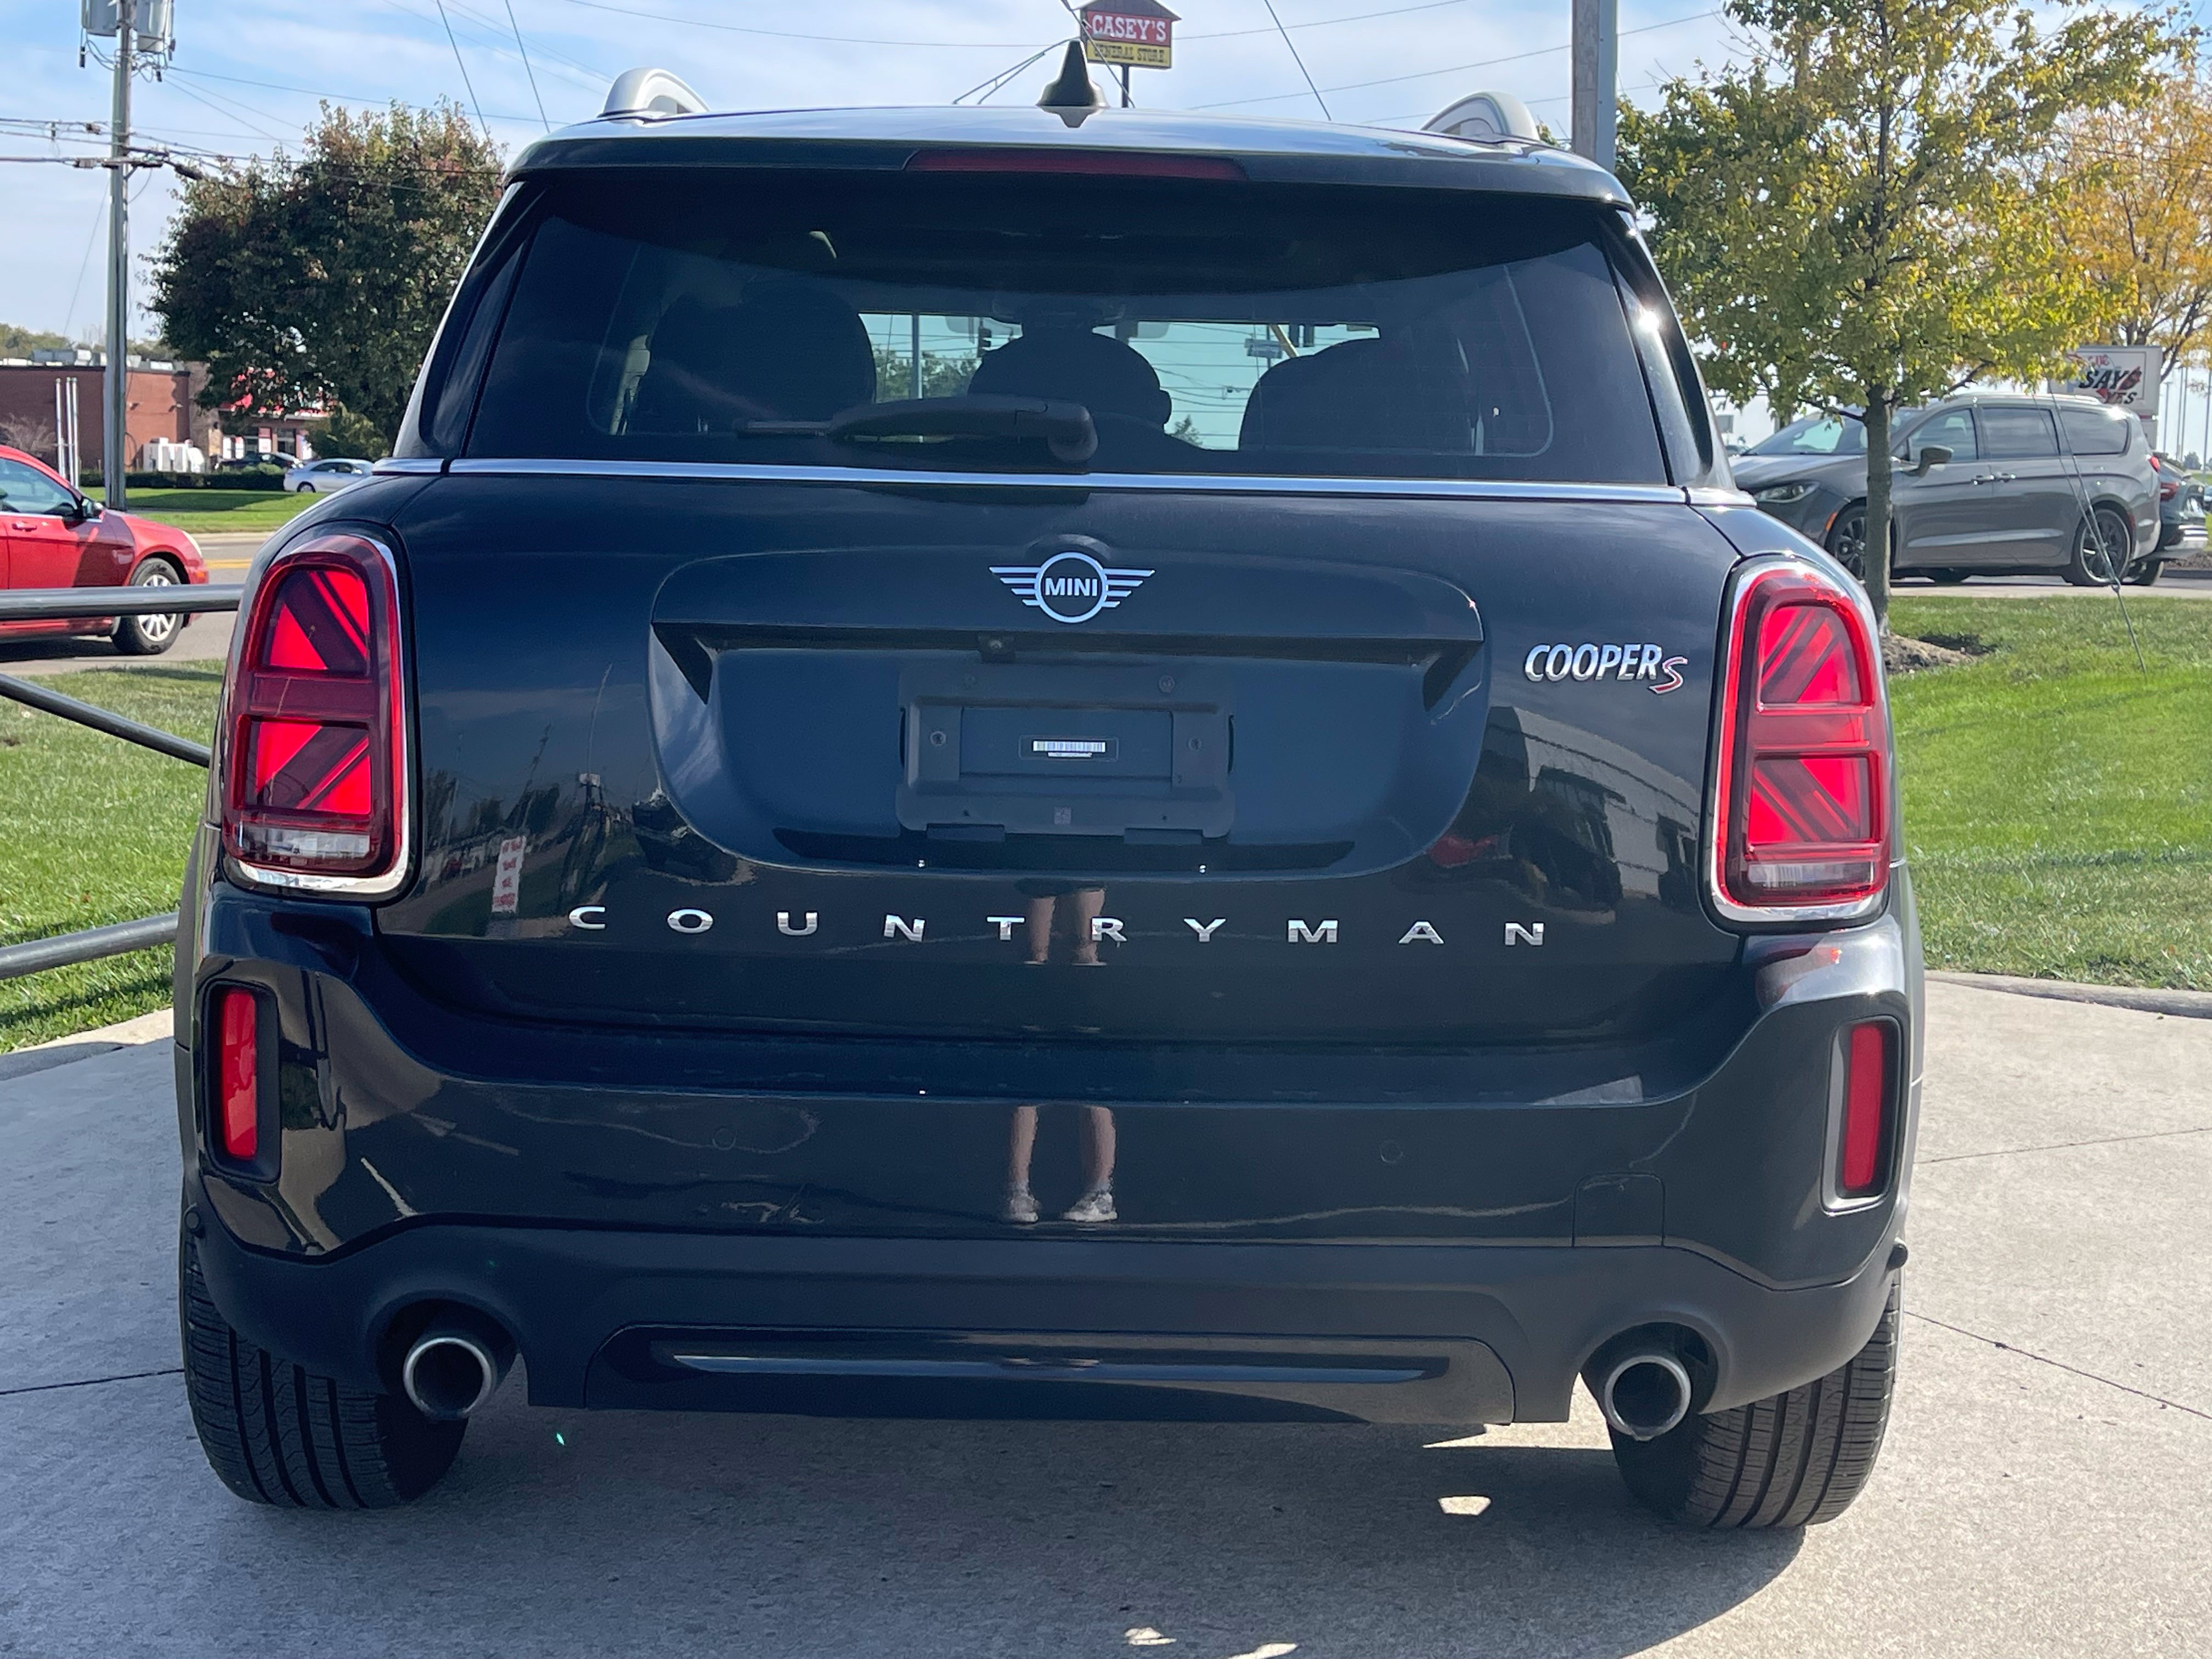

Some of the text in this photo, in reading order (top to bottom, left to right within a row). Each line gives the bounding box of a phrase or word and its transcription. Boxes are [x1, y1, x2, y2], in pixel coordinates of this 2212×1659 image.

[1091, 14, 1166, 42] CASEY'S
[1045, 578, 1098, 596] MINI
[1524, 643, 1663, 682] COOPER
[568, 906, 1544, 946] COUNTRYMAN
